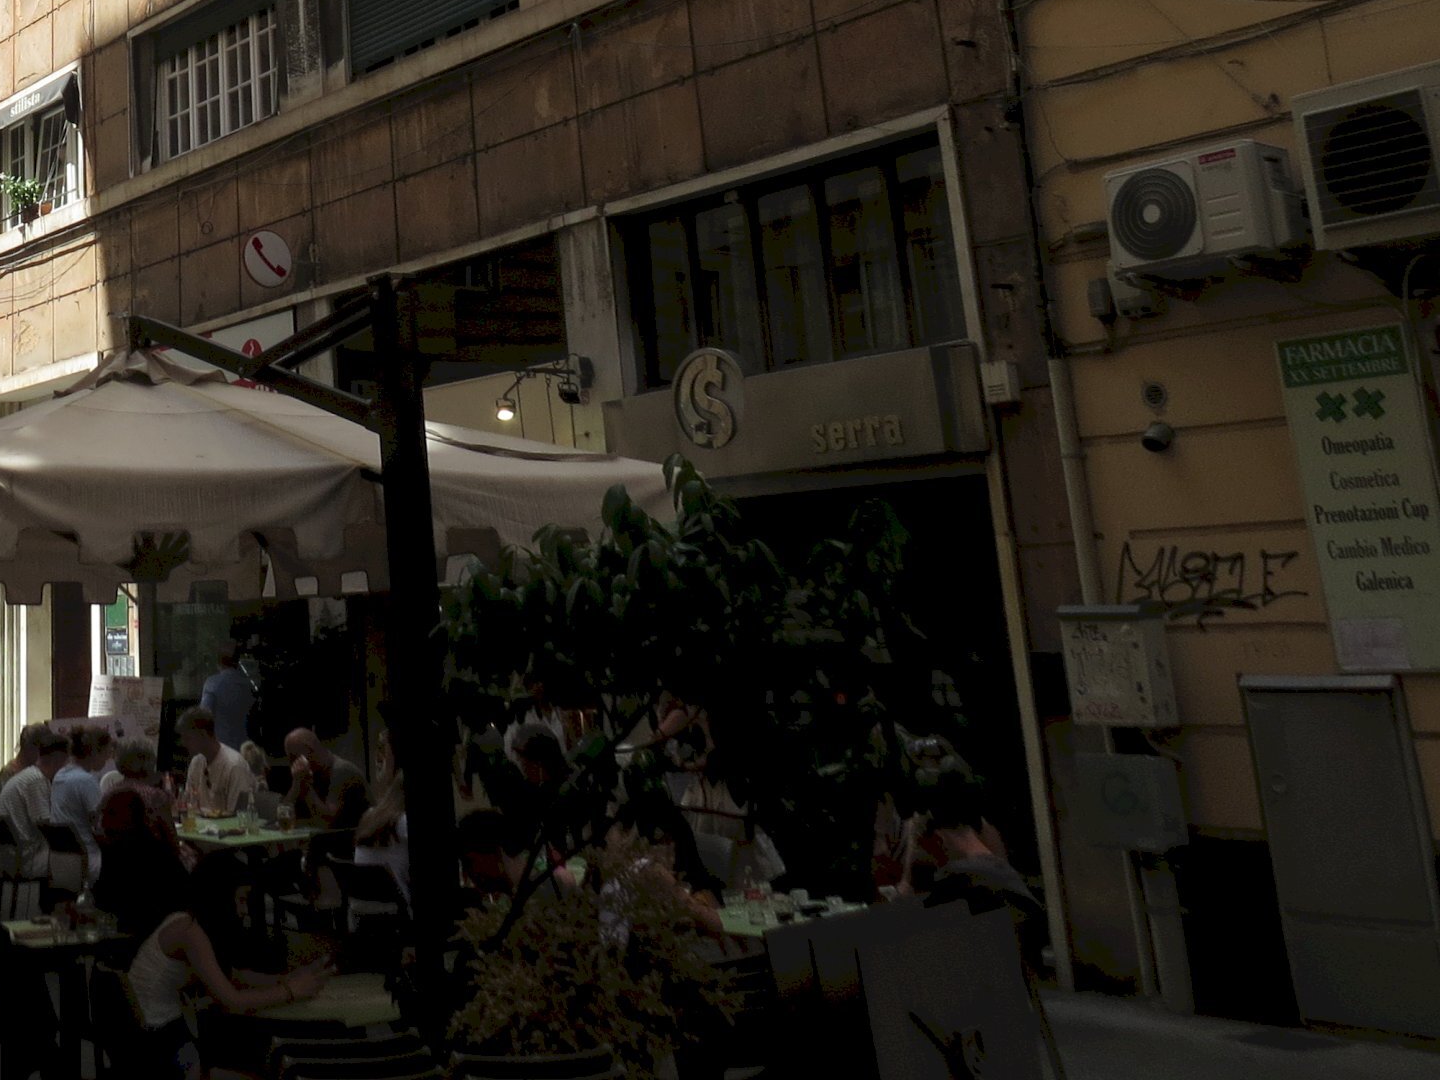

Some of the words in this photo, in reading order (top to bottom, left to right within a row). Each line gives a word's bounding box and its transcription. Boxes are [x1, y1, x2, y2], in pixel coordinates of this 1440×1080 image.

[9, 92, 41, 118] stilista
[1284, 334, 1397, 365] FARMACIA
[1288, 369, 1310, 383] XX
[1312, 357, 1401, 380] SETTEMBRE
[810, 413, 905, 455] serra
[1321, 431, 1396, 456] Omeopatia
[1329, 469, 1401, 491] Cosmetica
[1313, 500, 1400, 524] Prenotazioni
[1401, 497, 1429, 521] Cup
[1326, 537, 1379, 560] Cambio
[1379, 535, 1431, 557] Medico
[1355, 570, 1414, 592] Galenica
